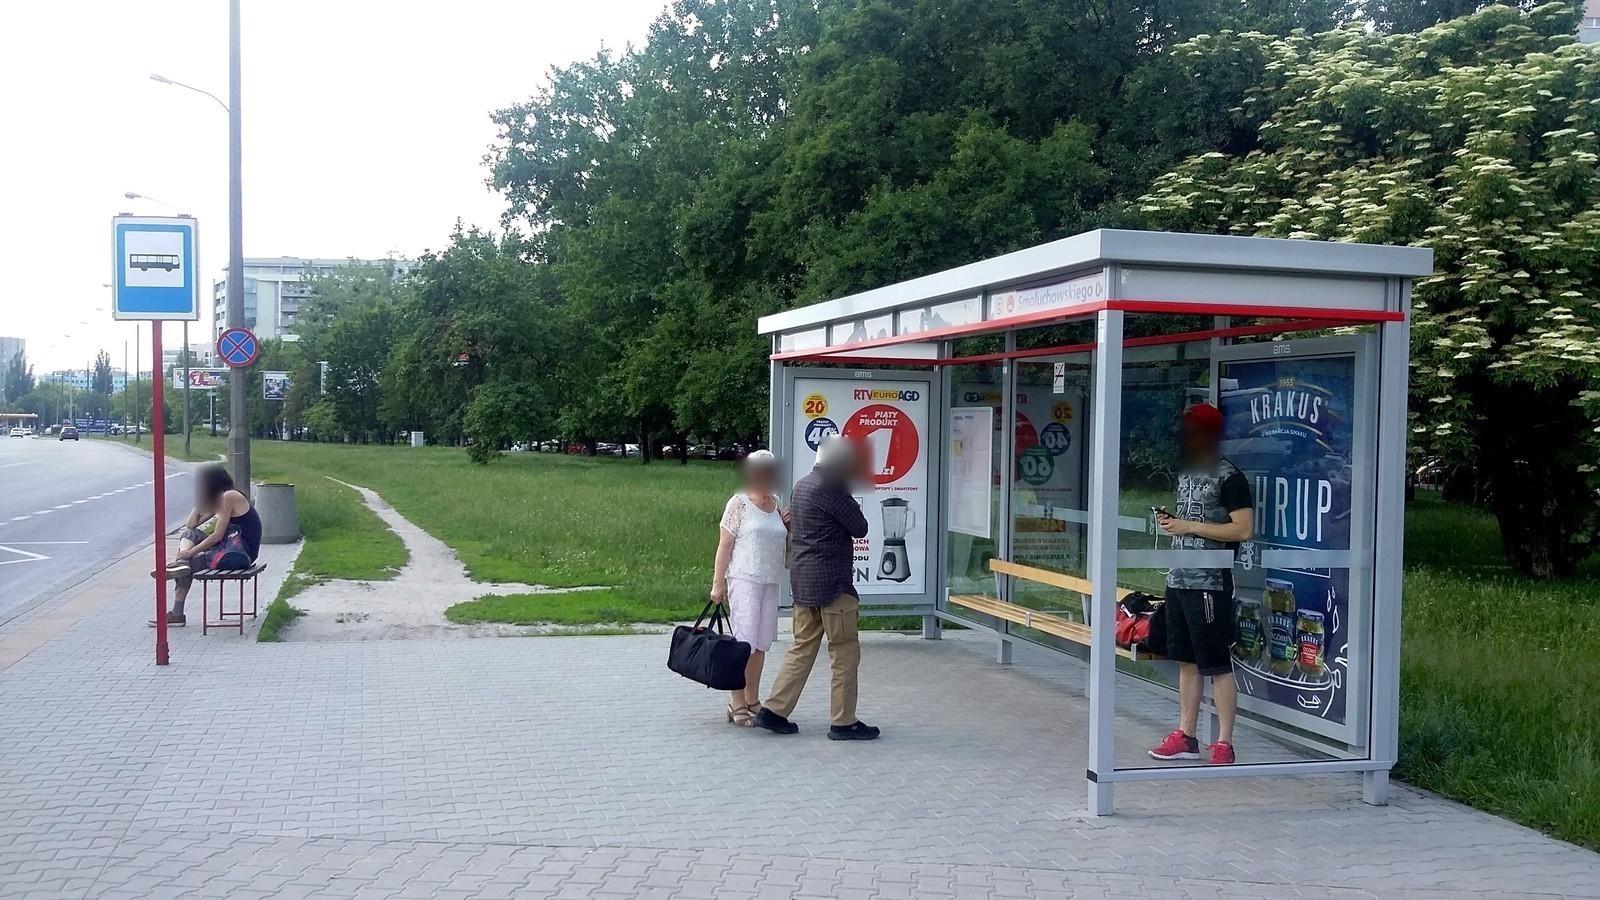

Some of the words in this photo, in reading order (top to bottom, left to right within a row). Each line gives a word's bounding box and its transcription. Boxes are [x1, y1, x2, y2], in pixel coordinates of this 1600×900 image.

[1095, 281, 1104, 297] 0
[1272, 344, 1291, 354] ams
[853, 389, 873, 400] RTV
[897, 390, 920, 401] AGD
[1250, 390, 1322, 424] KRAKUS
[1254, 475, 1332, 543] HRUP
